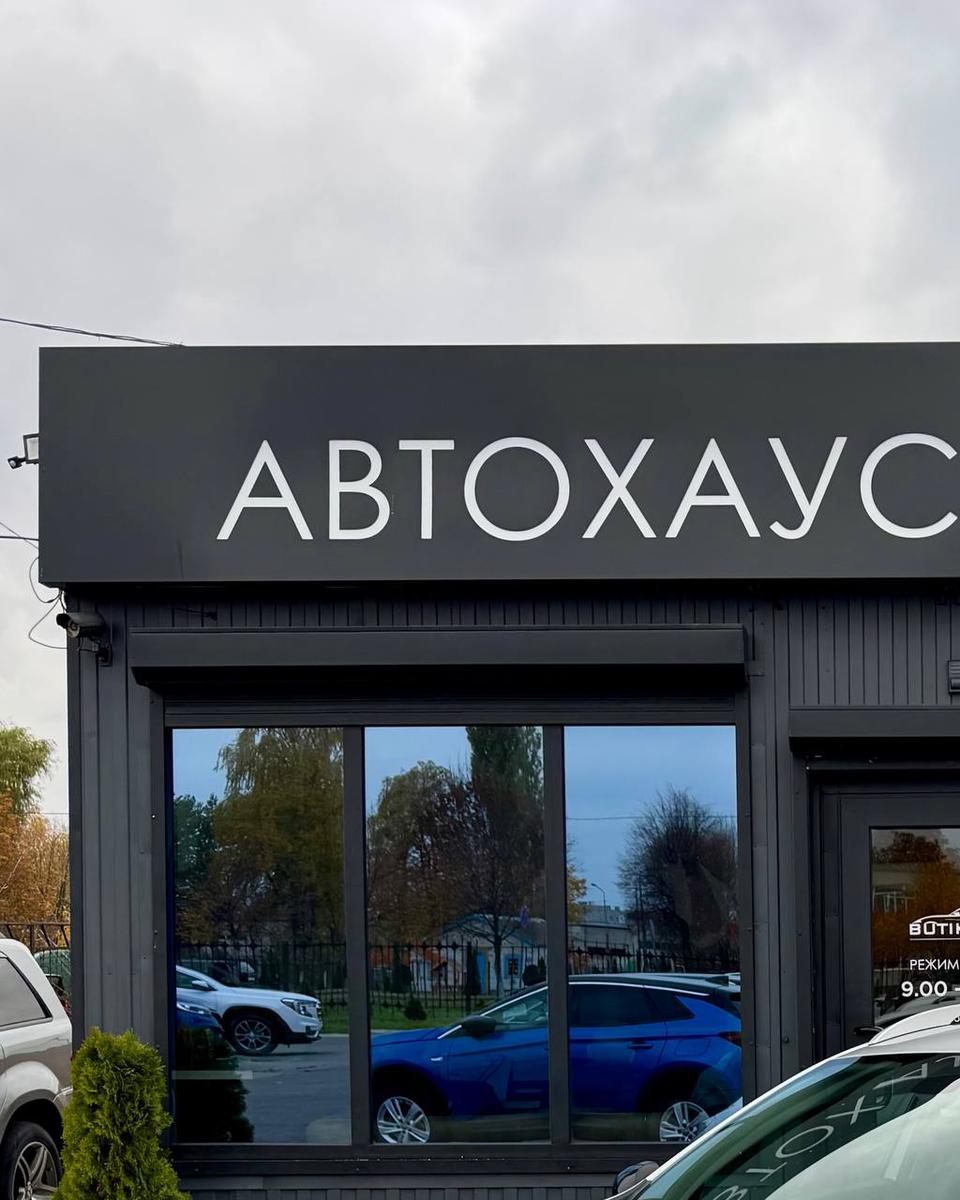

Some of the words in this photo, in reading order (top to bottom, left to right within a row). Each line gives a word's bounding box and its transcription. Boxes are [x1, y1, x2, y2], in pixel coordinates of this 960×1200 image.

[217, 433, 958, 542] АВТОХАУС
[909, 958, 960, 971] РЕЖИМ
[901, 980, 948, 997] 9.00
